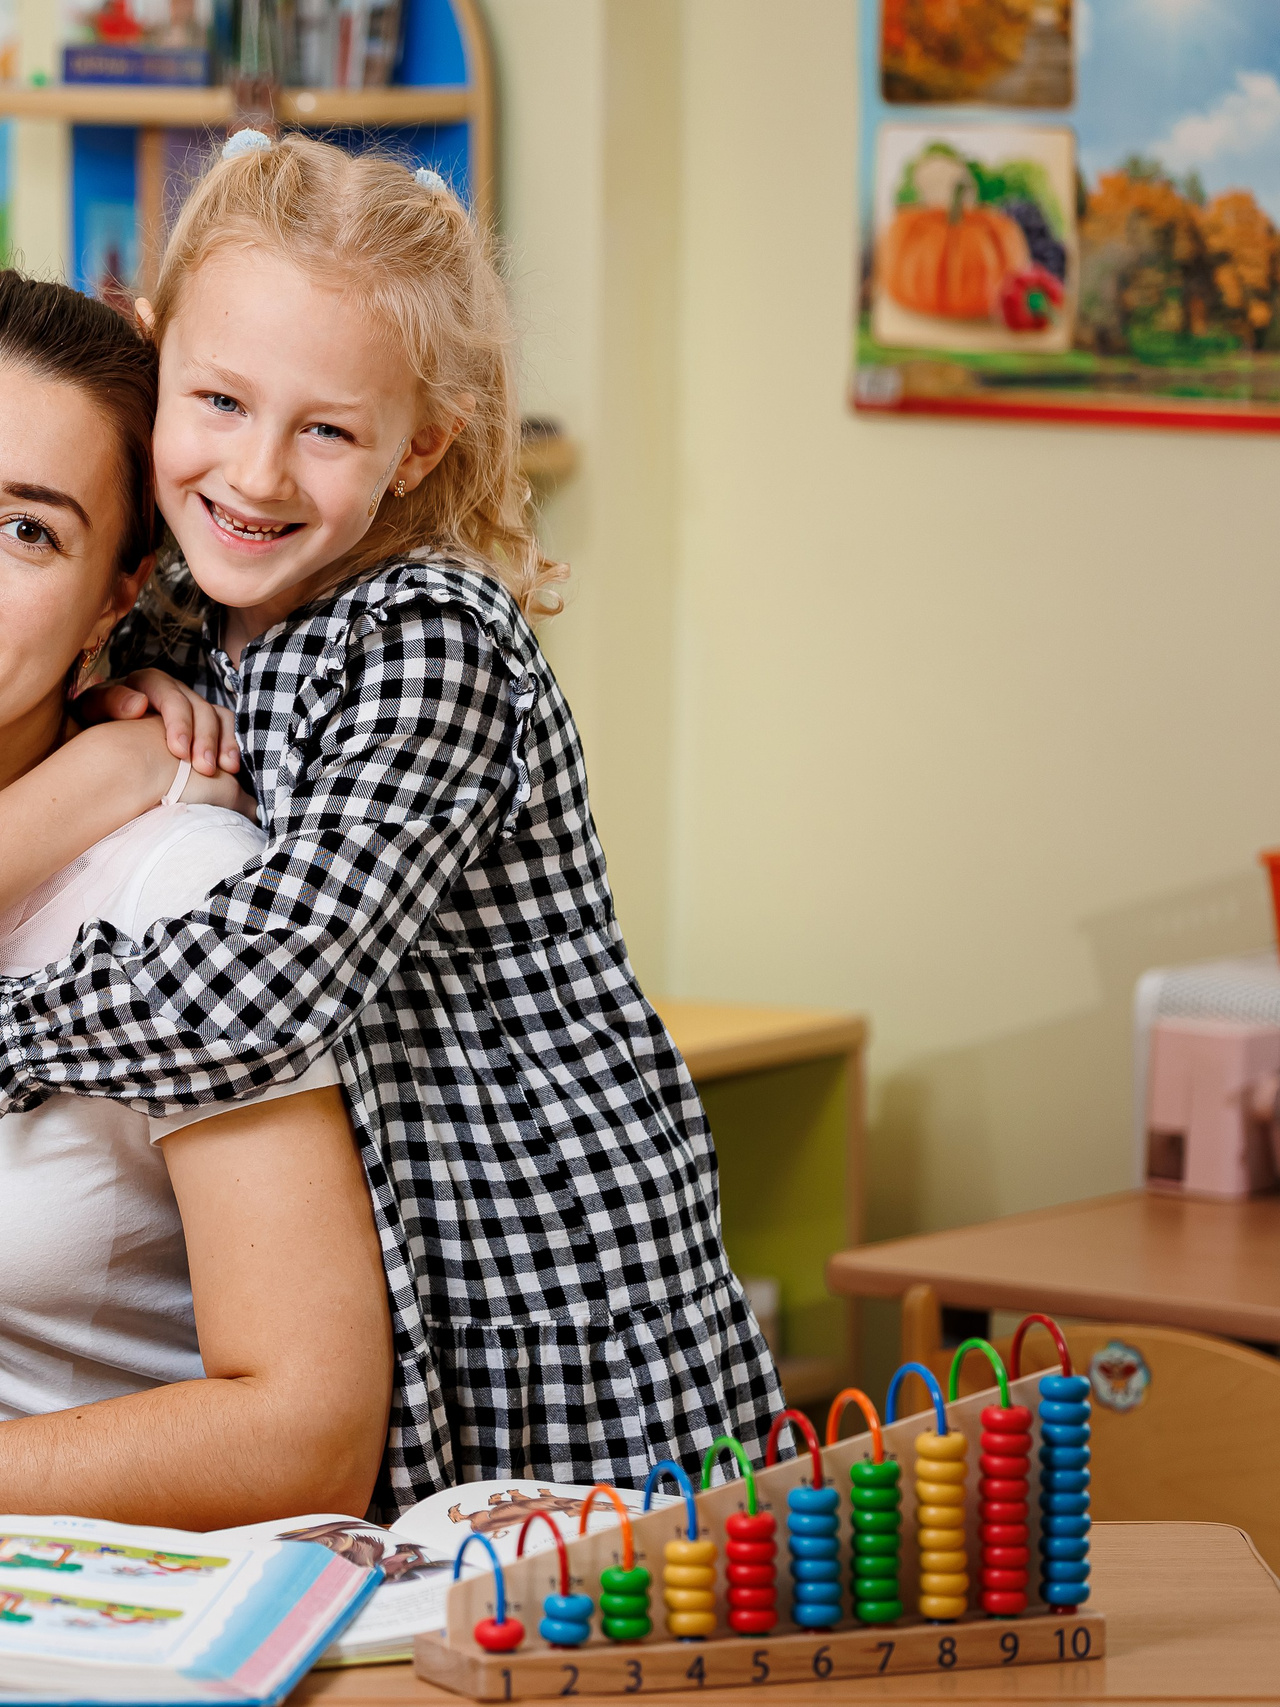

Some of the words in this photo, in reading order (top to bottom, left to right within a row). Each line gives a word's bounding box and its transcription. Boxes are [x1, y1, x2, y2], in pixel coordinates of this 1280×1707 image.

[501, 1669, 512, 1701] 1
[561, 1665, 579, 1697] 2
[625, 1660, 643, 1693] 3
[687, 1655, 706, 1687] 4
[753, 1650, 770, 1683] 5
[813, 1645, 833, 1678] 6
[876, 1642, 895, 1674] 7
[938, 1637, 957, 1668] 8
[1000, 1632, 1019, 1664] 9
[1054, 1627, 1091, 1660] 10
